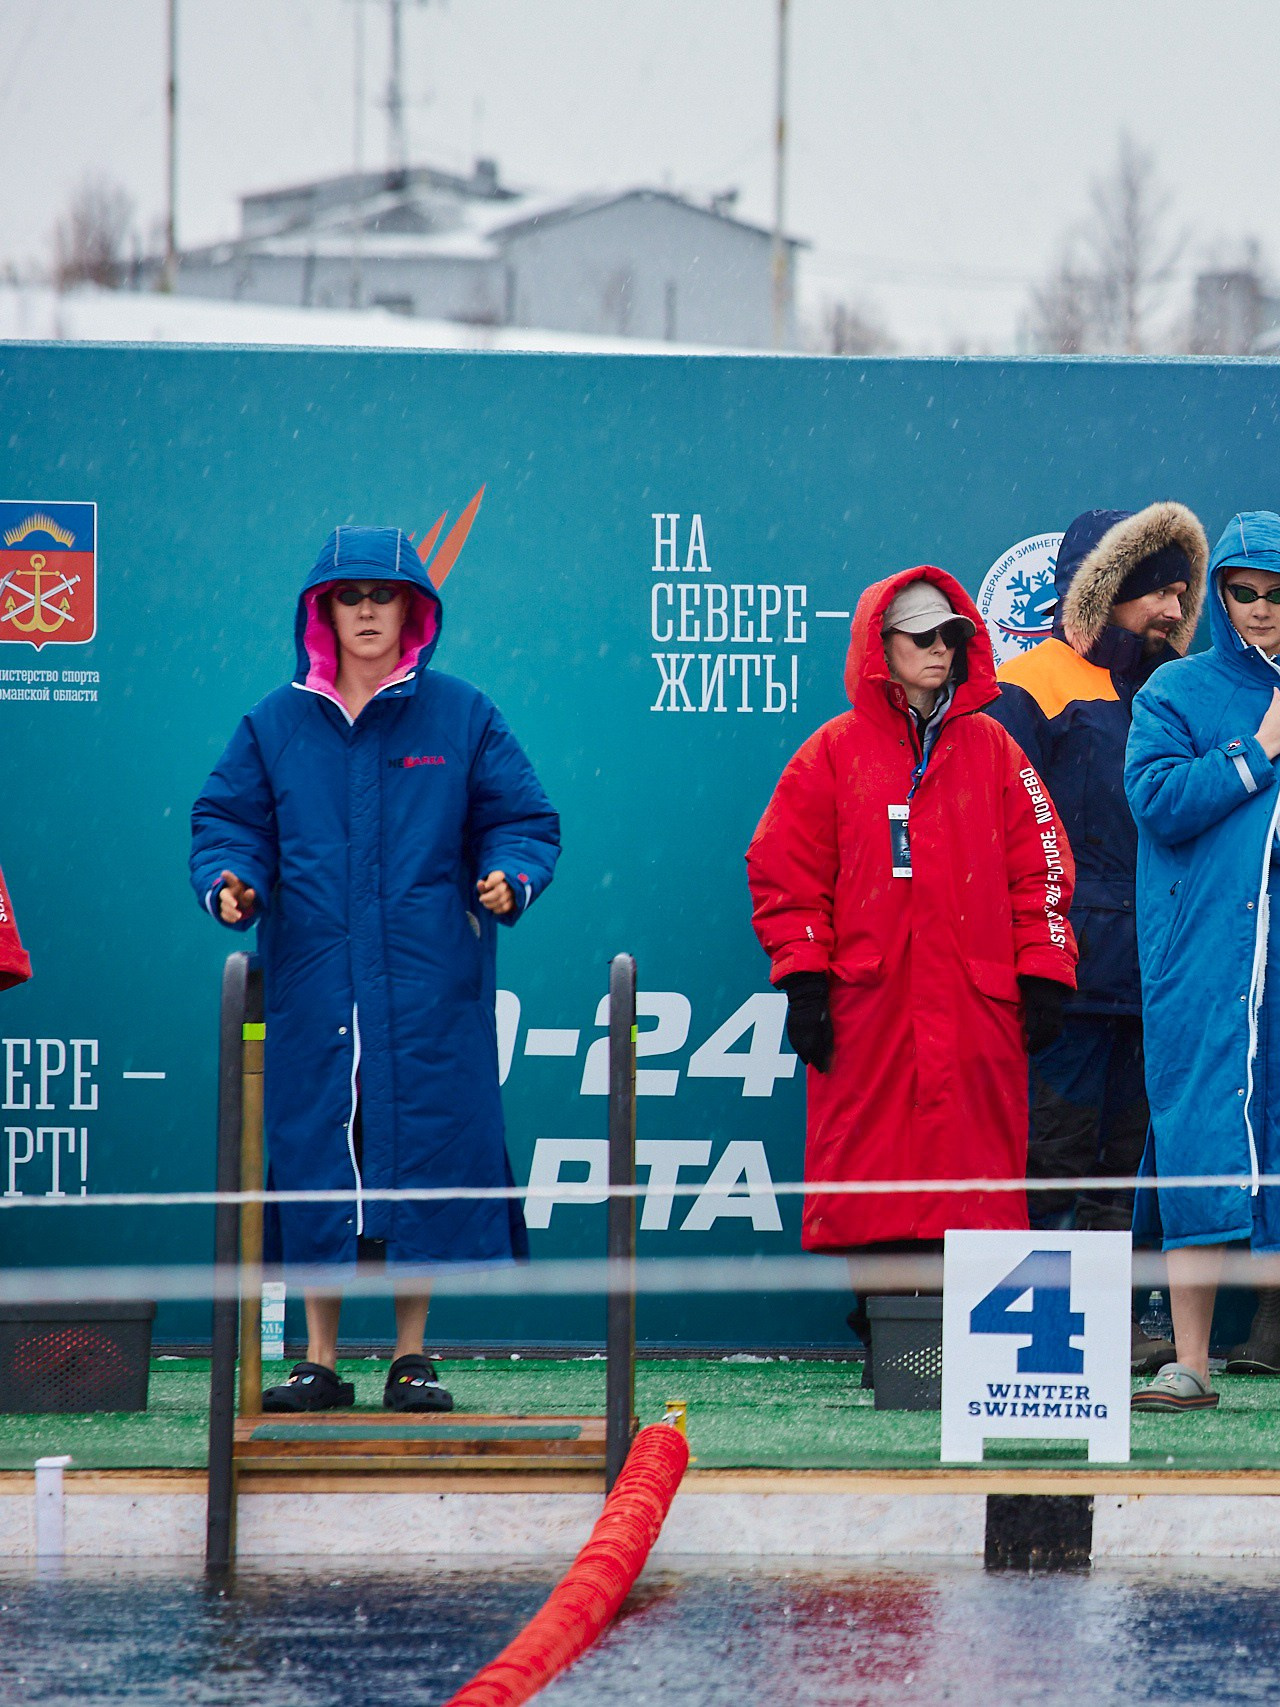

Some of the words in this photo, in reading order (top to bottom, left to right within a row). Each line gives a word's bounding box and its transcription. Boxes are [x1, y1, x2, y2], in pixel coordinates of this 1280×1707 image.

[652, 513, 711, 572] НА
[651, 583, 807, 643] СЕВЕРЕ
[982, 555, 1016, 615] ФЕДЕРАЦИЯ
[53, 689, 98, 702] области
[62, 671, 99, 685] спорта
[650, 653, 797, 713] ЖИТЬ!
[1019, 766, 1054, 825] NOREBO
[1040, 826, 1065, 882] FUTURE.
[2, 1038, 98, 1110] ЕРЕ
[4, 1126, 88, 1197] РТ!
[969, 1250, 1085, 1374] 4
[968, 1402, 1108, 1418] SWIMMING
[987, 1384, 1090, 1400] WINTER
